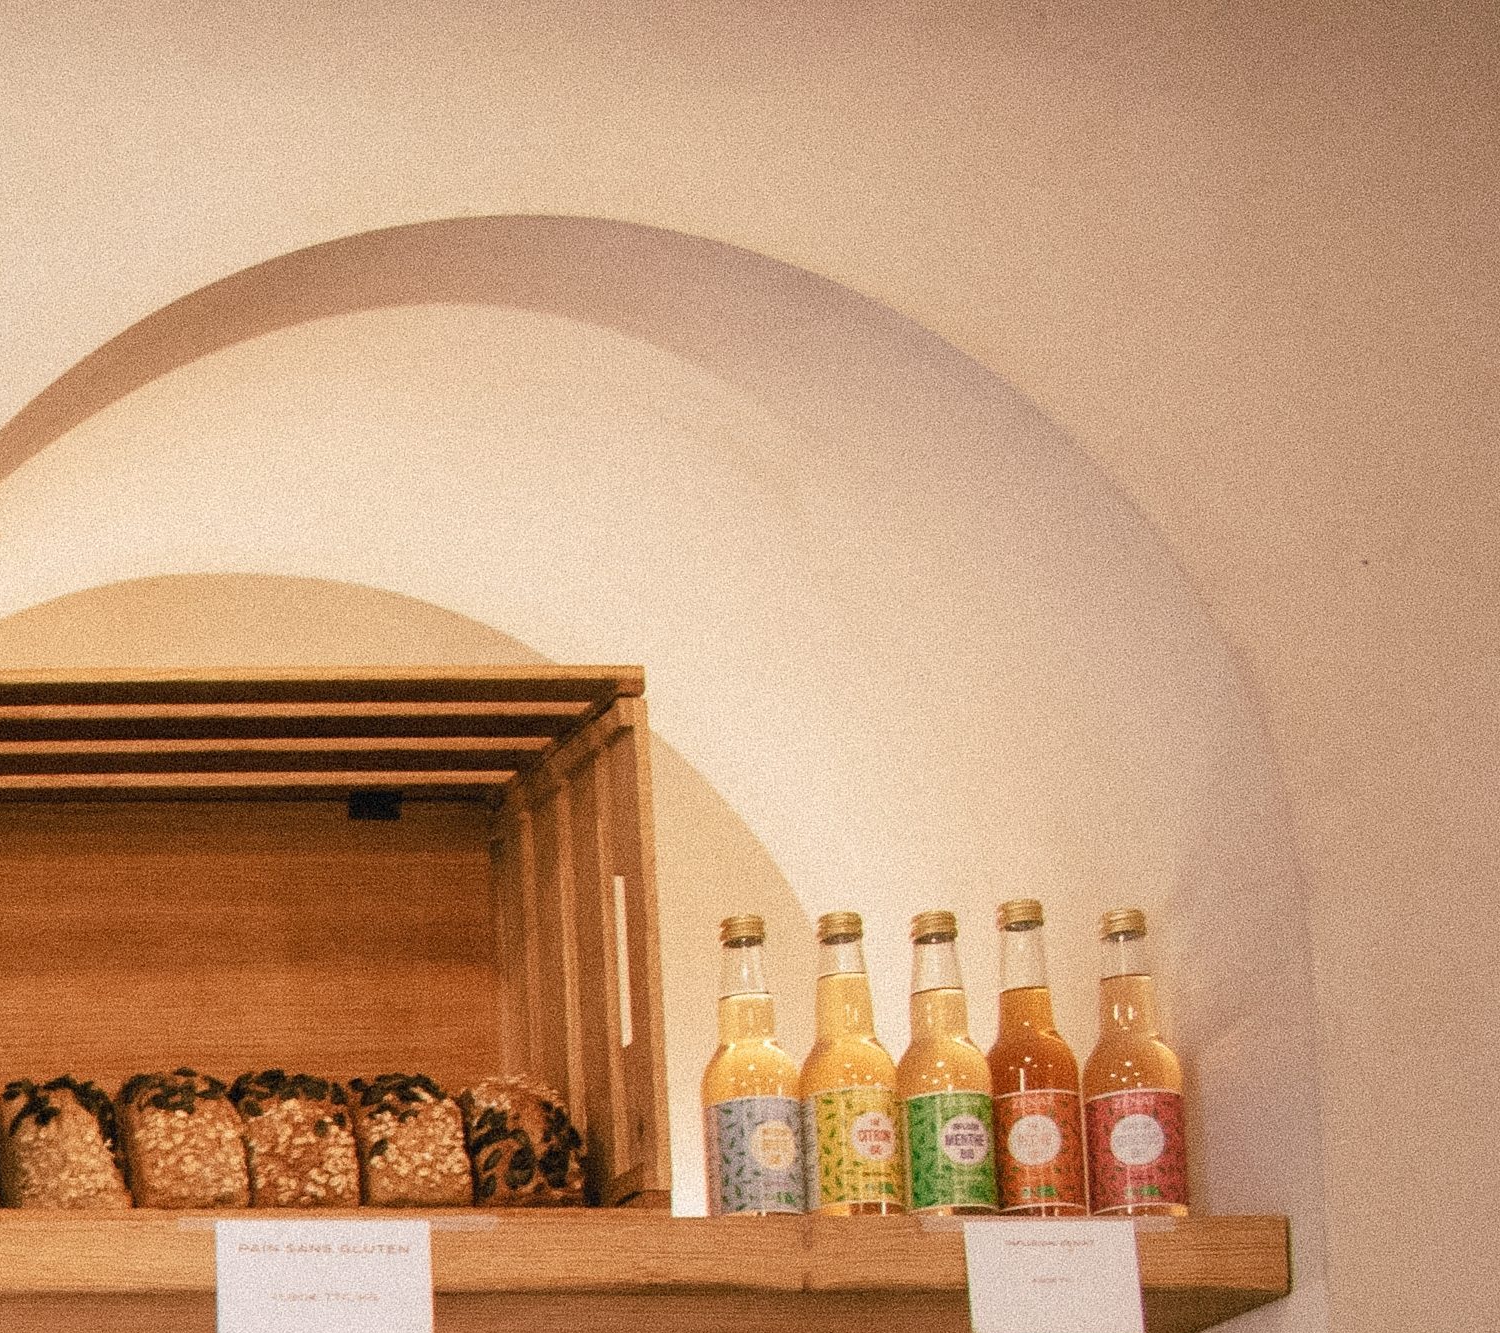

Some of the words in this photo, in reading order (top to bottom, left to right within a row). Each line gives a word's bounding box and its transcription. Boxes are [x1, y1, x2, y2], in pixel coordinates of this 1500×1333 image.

[945, 1134, 985, 1147] MENTHE
[237, 1243, 280, 1254] PAIN
[286, 1243, 332, 1255] SANS
[338, 1243, 411, 1255] GLUTEN
